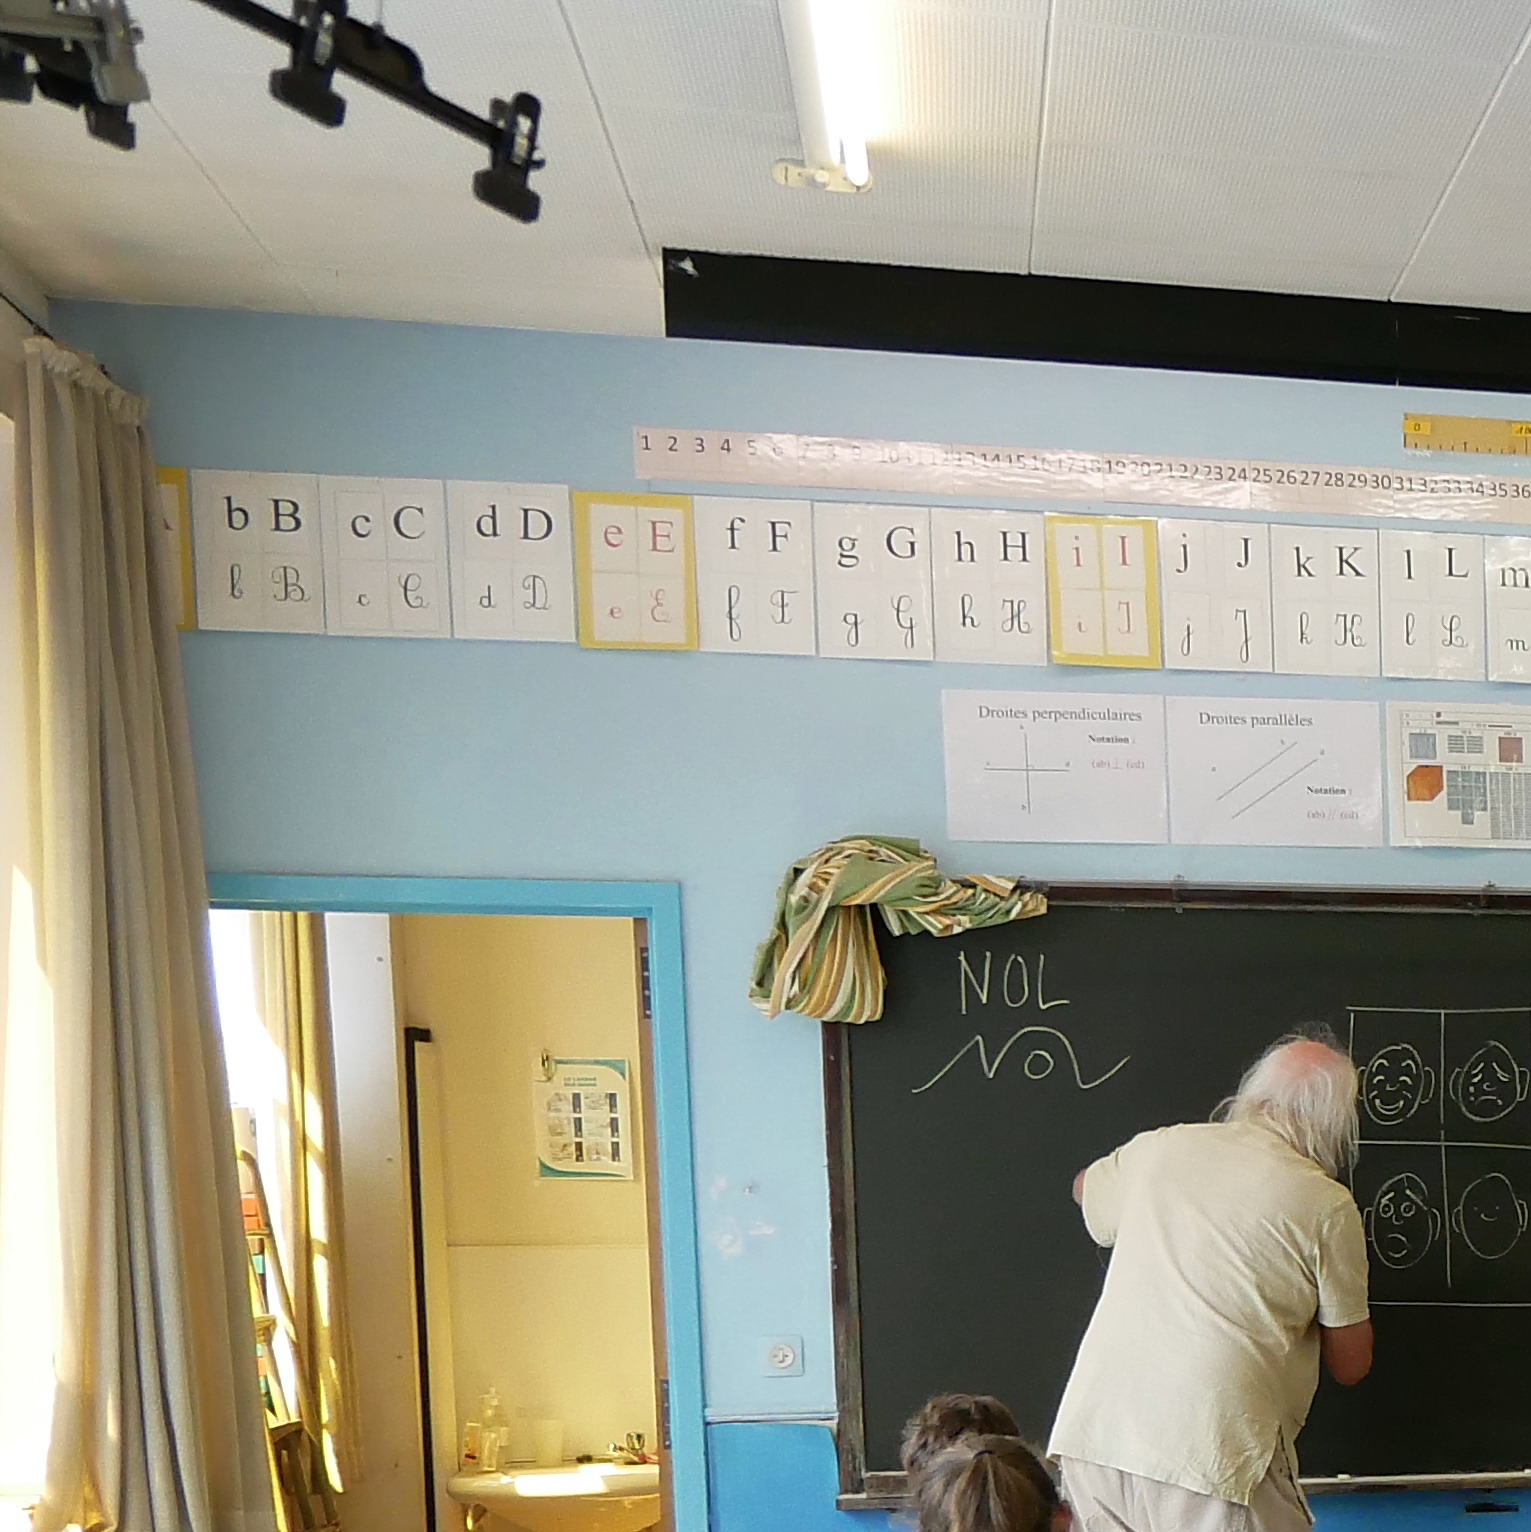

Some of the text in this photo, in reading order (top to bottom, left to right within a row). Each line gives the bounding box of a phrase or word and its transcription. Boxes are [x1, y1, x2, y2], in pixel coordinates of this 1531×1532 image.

[642, 435, 651, 450] 1
[668, 436, 678, 452] 2
[696, 438, 704, 453] 3
[721, 439, 731, 453] 4
[747, 440, 756, 455] 5
[1253, 468, 1272, 483] 25
[1301, 471, 1320, 485] 27
[1348, 473, 1367, 488] 29
[1372, 474, 1391, 489] 30
[1511, 484, 1531, 498] 36
[979, 706, 1142, 725] Droites perpendiculaires
[1199, 711, 1313, 730] Droites parallèles
[959, 950, 1070, 1015] NOL
